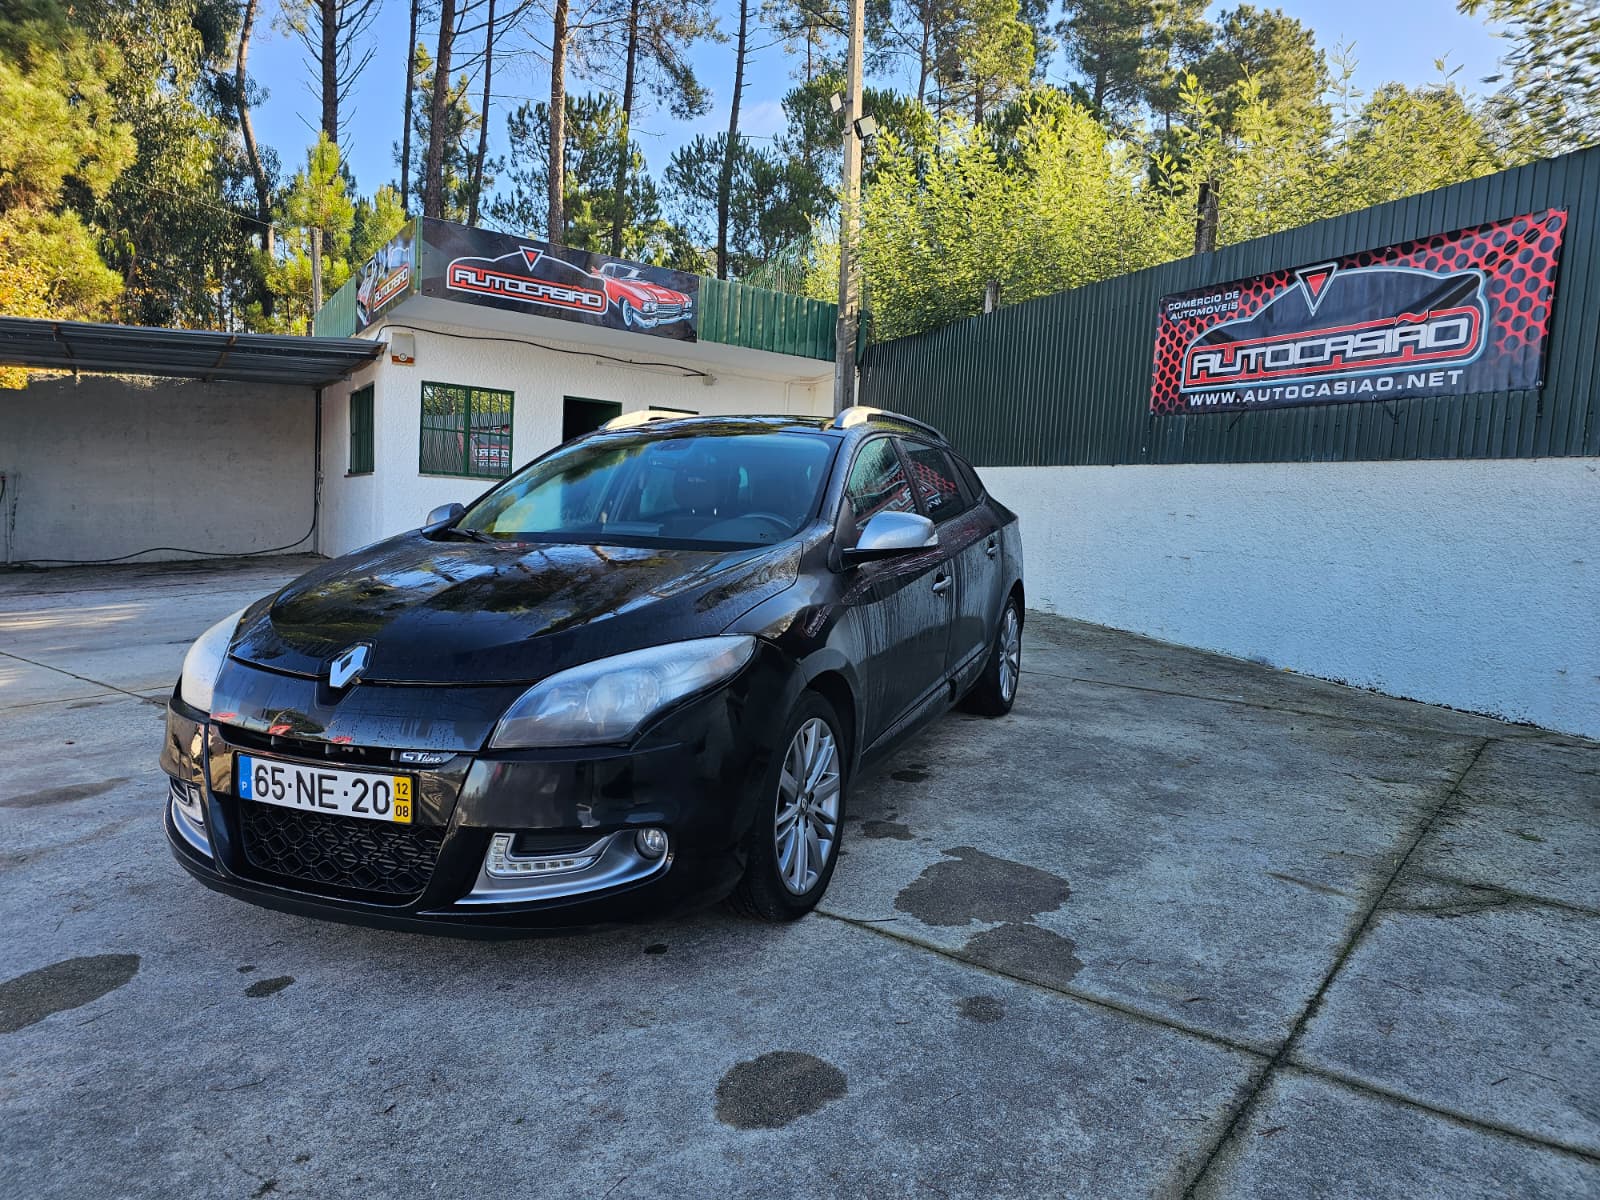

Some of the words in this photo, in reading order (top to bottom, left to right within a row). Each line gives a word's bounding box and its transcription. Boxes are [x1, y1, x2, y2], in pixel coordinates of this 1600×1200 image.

[1224, 290, 1239, 300] DE
[1192, 312, 1469, 376] AUTOCASIÃO
[1189, 369, 1463, 406] WWW.AUTOCASIAO.NET
[241, 781, 248, 791] P
[395, 782, 409, 795] 12
[395, 804, 409, 818] 08
